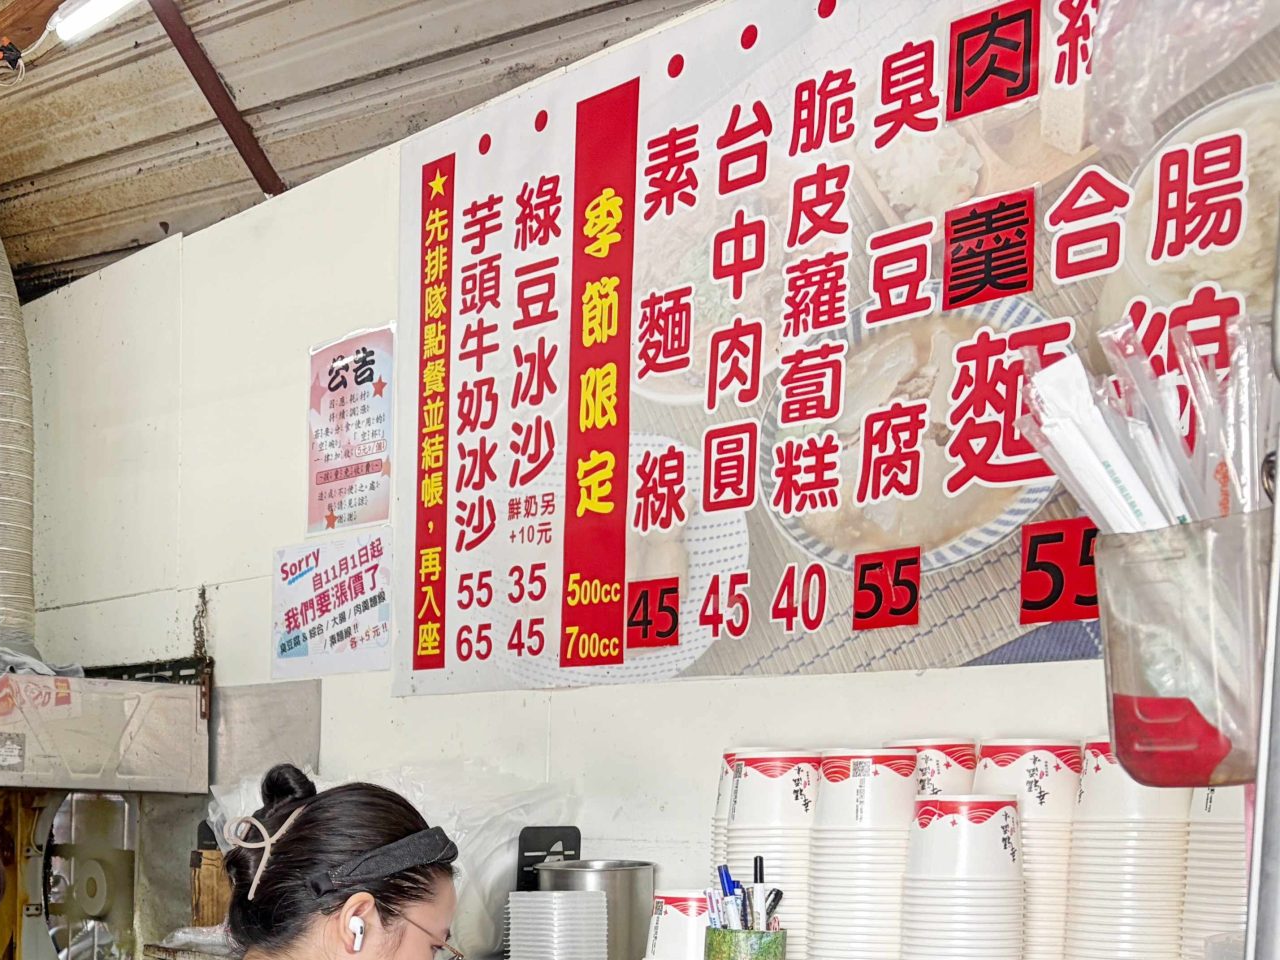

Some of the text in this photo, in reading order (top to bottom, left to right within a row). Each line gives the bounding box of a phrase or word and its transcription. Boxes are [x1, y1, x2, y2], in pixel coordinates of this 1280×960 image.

[948, 8, 1033, 306] 肉羹
[773, 67, 857, 515] 脆皮蘿蔔糕
[857, 40, 940, 503] 臭豆腐
[508, 174, 563, 489] 綠豆冰沙
[633, 124, 700, 533] 素麵線
[702, 100, 773, 513] 台中肉圓
[326, 346, 376, 394] 公告
[455, 193, 504, 553] 芋頭牛奶冰沙
[576, 187, 624, 518] 季節限定
[507, 491, 556, 522] 鮮奶另
[509, 521, 552, 546] +10元
[280, 547, 321, 582] Sorry
[312, 537, 384, 593] 自11月1日起
[457, 569, 493, 610] 55
[507, 562, 547, 604] 35
[567, 572, 621, 607] 500cc
[854, 558, 919, 620] 55
[284, 563, 380, 635] 我們要漲價了
[627, 586, 679, 639] 45
[699, 572, 750, 638] 45
[771, 562, 827, 632] 40
[456, 622, 493, 662] 65
[507, 617, 545, 657] 45
[565, 625, 620, 660] 700cc
